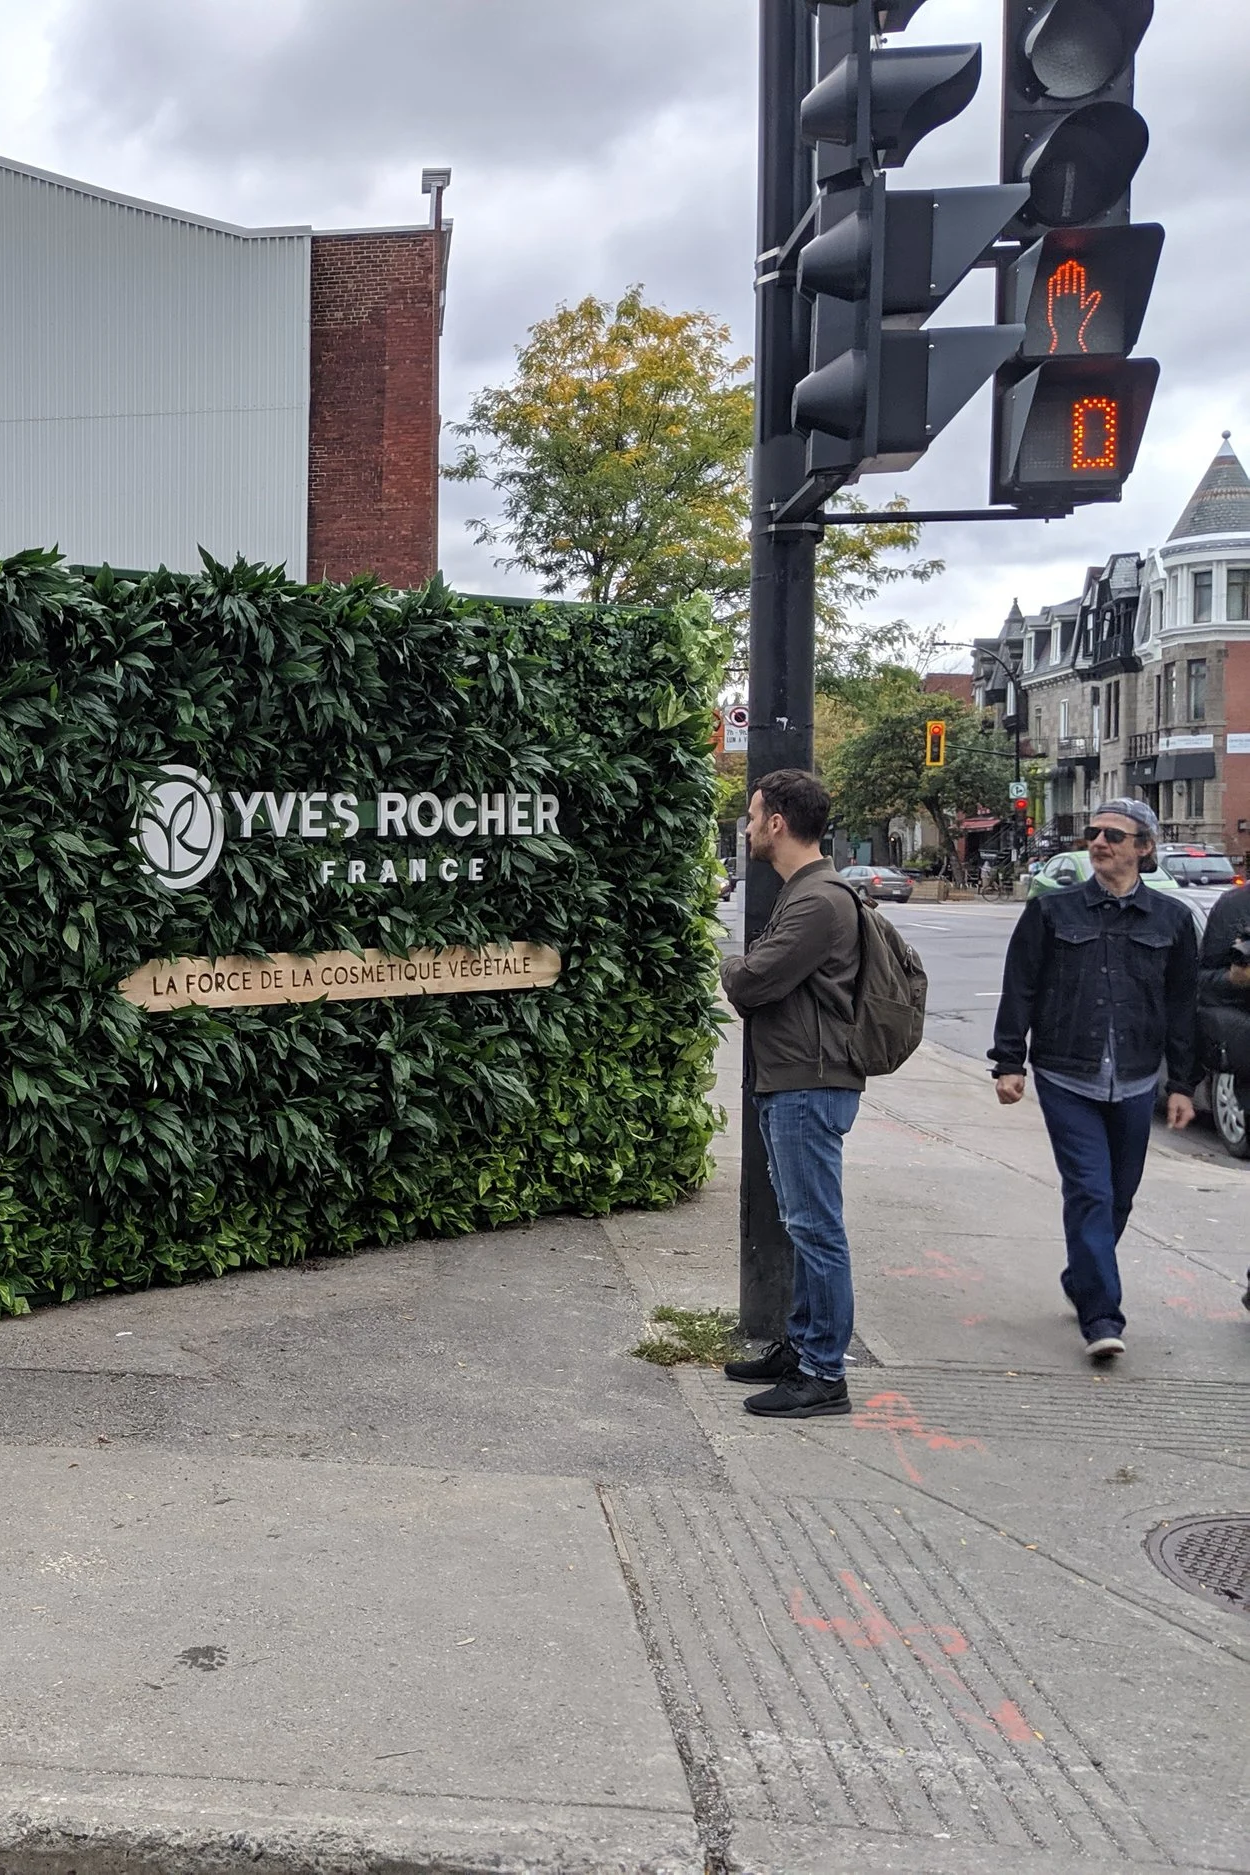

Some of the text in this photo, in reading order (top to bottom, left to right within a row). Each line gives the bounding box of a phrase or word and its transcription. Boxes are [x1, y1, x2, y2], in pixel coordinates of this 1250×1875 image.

[228, 791, 560, 838] YVES ROCHER
[321, 858, 484, 884] FRANCE
[152, 975, 178, 997] LA
[186, 971, 252, 993] FORCE
[260, 970, 283, 990] DE
[291, 968, 314, 987] LA
[320, 959, 442, 986] COSMÉTIQUE
